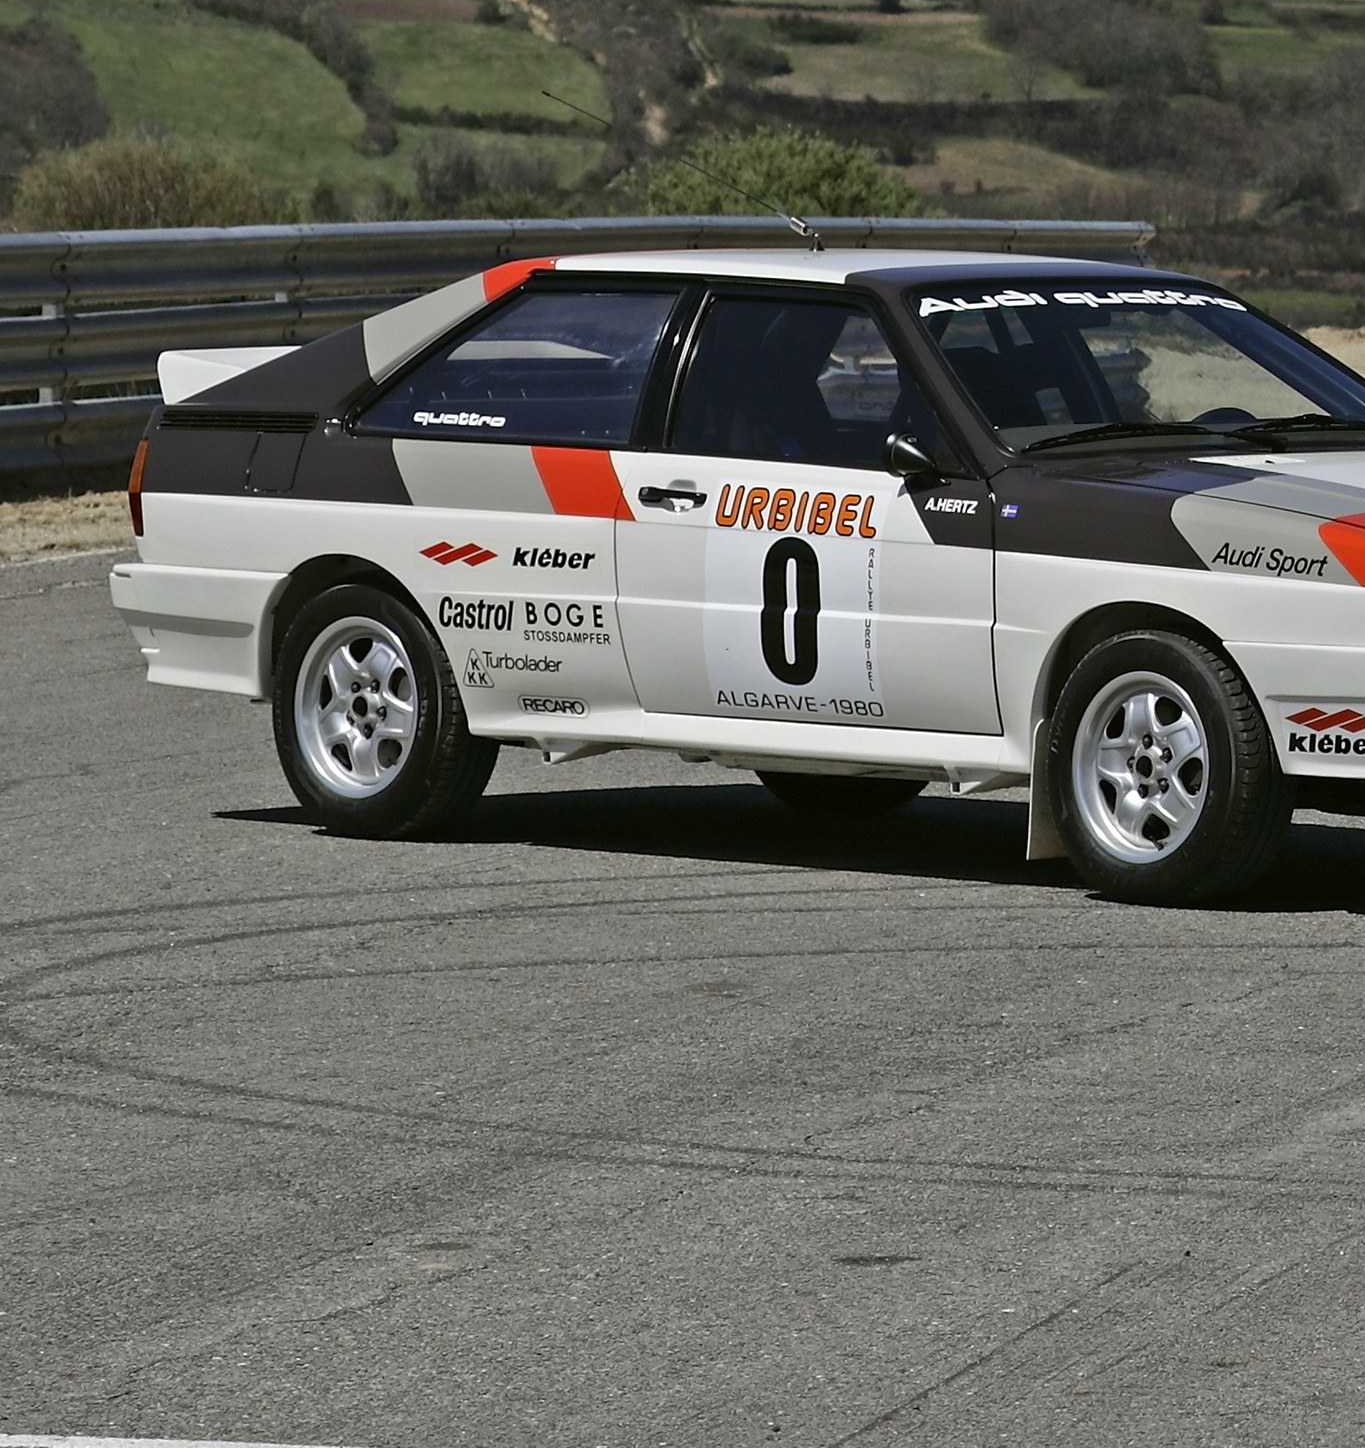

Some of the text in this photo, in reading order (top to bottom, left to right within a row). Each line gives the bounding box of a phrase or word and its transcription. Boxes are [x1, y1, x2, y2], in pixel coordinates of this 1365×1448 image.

[918, 289, 1248, 317] Audi quattro
[413, 411, 506, 428] quattro
[715, 483, 877, 539] URBIBEL
[925, 497, 978, 514] A.HERTZ
[512, 547, 596, 570] kléber
[1211, 542, 1328, 577] Audi Sport
[438, 596, 515, 631] Castrol
[525, 601, 604, 629] BOGE
[760, 536, 821, 686] 0
[864, 548, 876, 692] RALLYE URBIBEL
[523, 629, 612, 645] STOSSDAMPFER
[482, 651, 563, 673] Turbolader
[522, 698, 585, 715] RECARO
[716, 690, 885, 718] ALGARVE-1980
